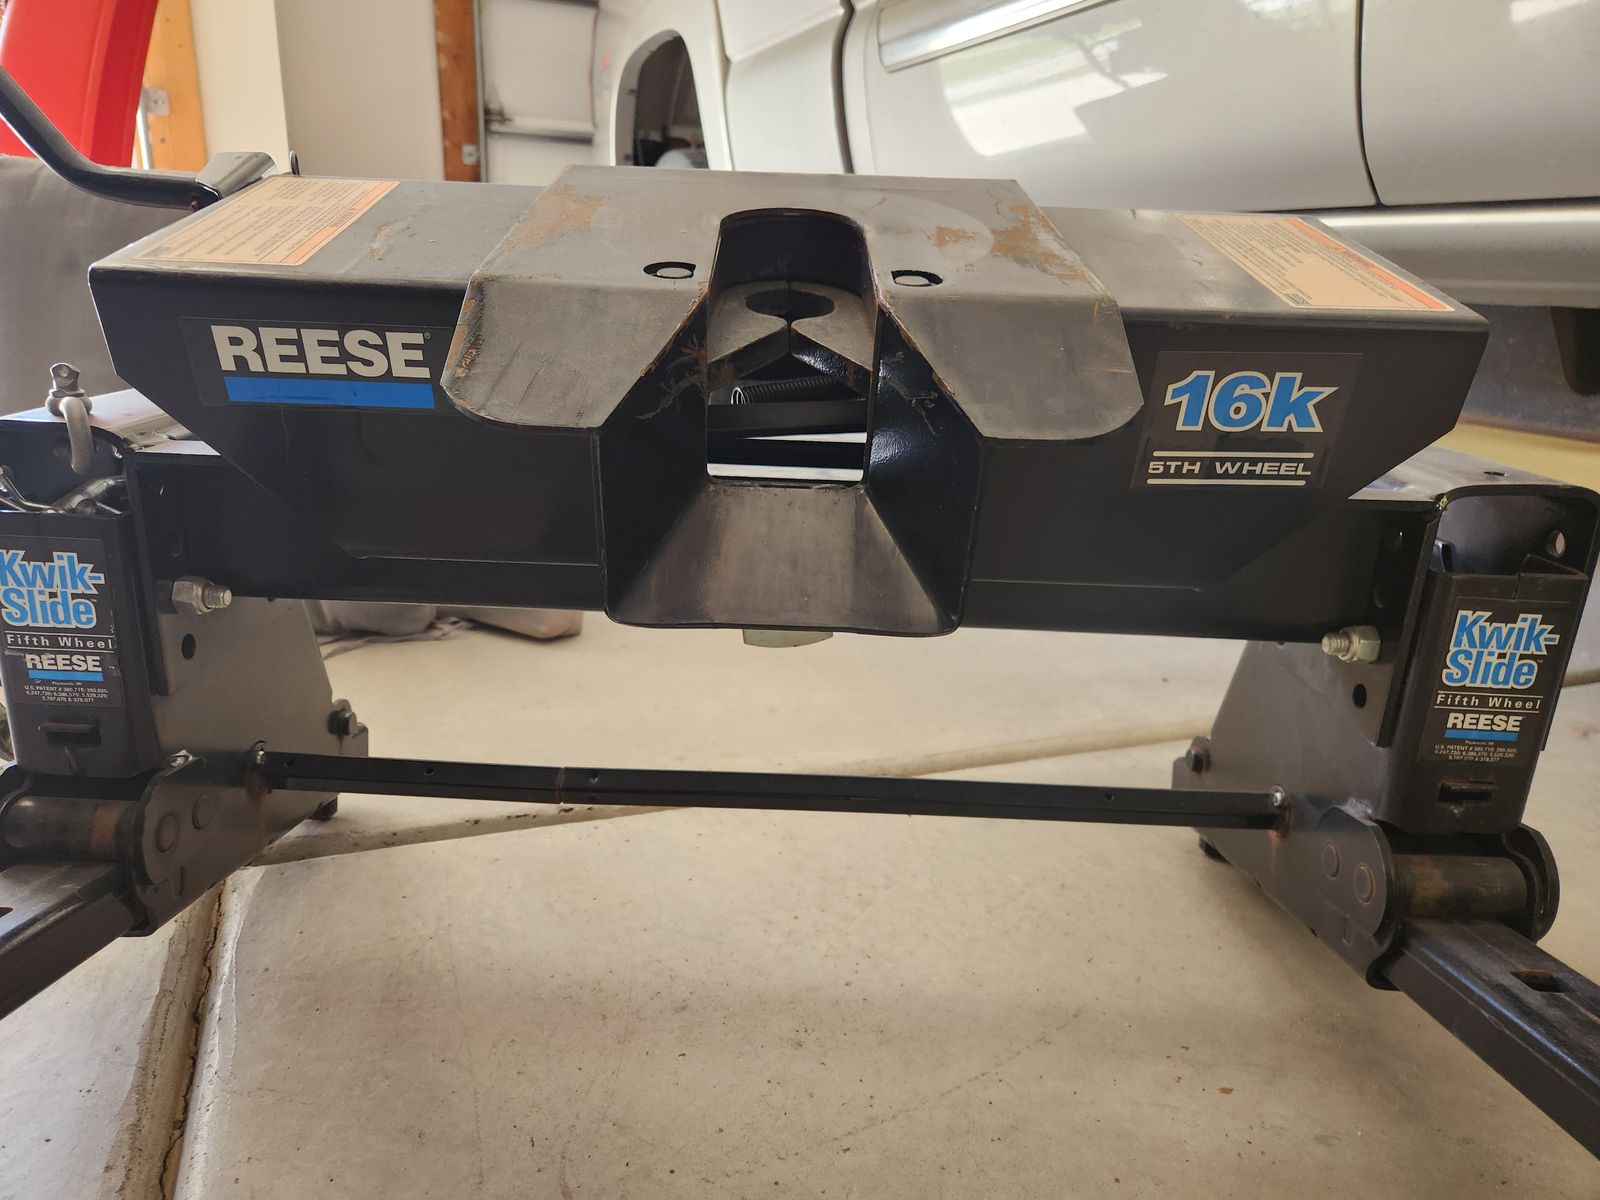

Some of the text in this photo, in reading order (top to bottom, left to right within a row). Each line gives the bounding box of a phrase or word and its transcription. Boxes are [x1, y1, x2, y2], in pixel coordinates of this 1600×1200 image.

[210, 324, 431, 379] REESE
[1163, 370, 1339, 433] 16k
[1147, 461, 1312, 475] 5TH WHEEL
[0, 549, 105, 594] Kwik-
[0, 587, 97, 629] Slide
[6, 634, 113, 649] Fifth Wheel
[1449, 610, 1560, 655] Kwik-
[25, 654, 103, 672] REESE
[1441, 649, 1538, 689] Slide
[1436, 694, 1541, 709] Fifth Wheel
[1446, 712, 1522, 732] REESE
